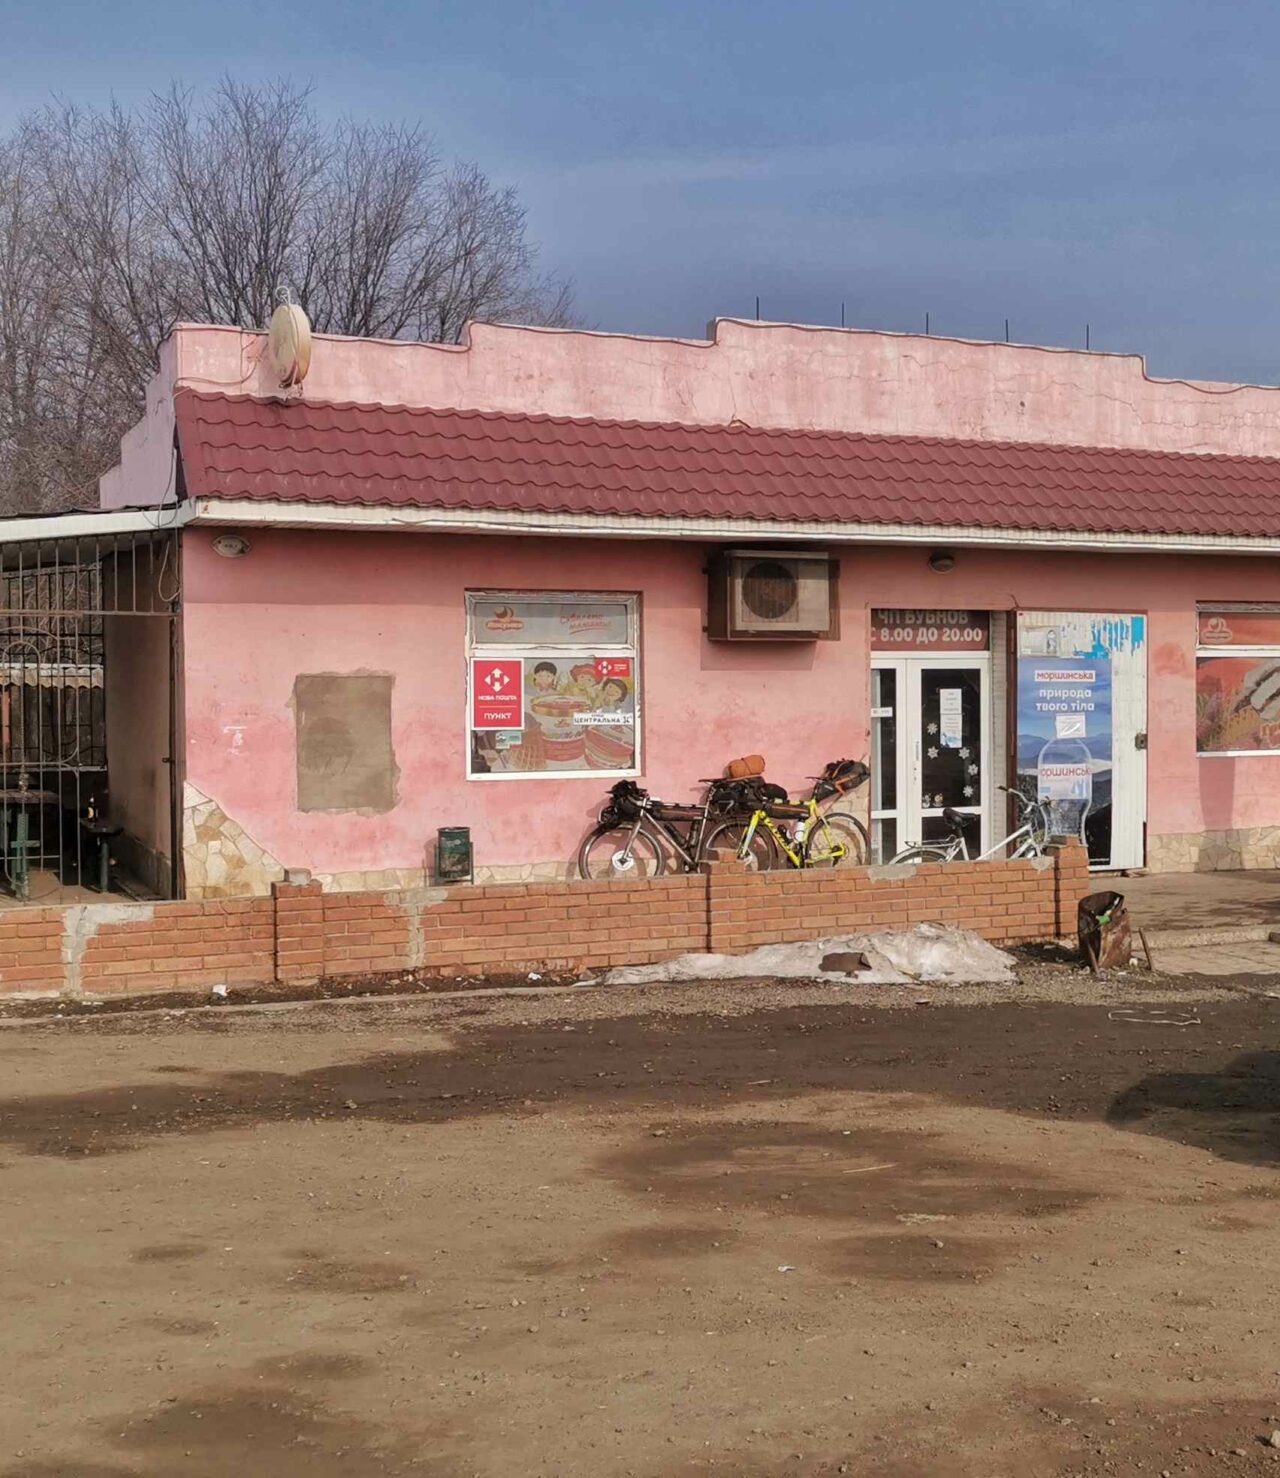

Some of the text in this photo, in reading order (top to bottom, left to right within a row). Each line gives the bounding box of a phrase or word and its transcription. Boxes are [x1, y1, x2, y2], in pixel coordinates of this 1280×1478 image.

[878, 609, 969, 624] ЧП БУБНОВ
[880, 627, 914, 642] 8.00
[916, 627, 938, 645] ДО
[942, 627, 982, 642] 20.00
[1036, 671, 1094, 681] моршинська
[1039, 689, 1092, 700] природа
[1036, 700, 1095, 711] твого тіла
[483, 712, 512, 720] ПУНКТ
